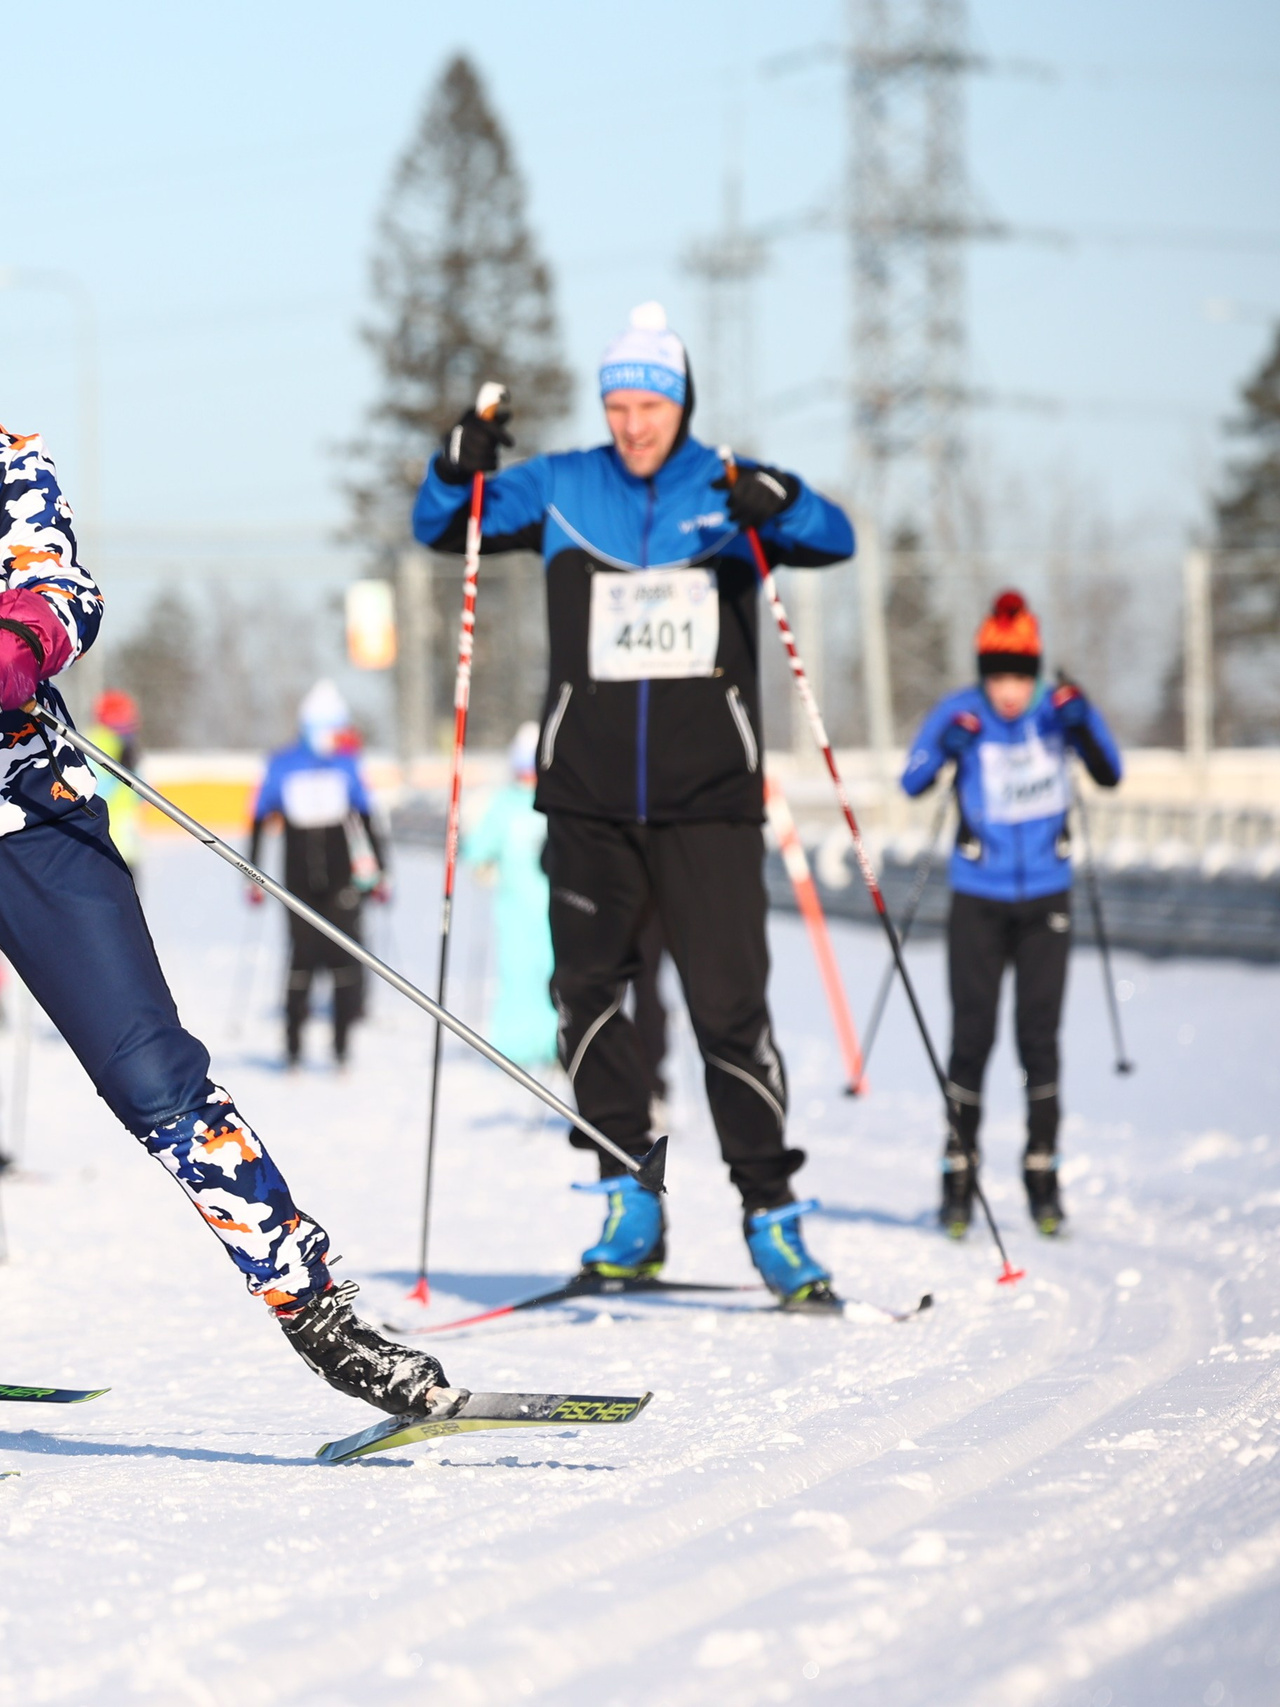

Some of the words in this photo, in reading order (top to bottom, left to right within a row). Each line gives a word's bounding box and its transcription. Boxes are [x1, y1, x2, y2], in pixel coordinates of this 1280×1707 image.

[616, 619, 693, 651] 4401
[235, 861, 266, 885] NORDWAY
[548, 1401, 638, 1421] FISCHER
